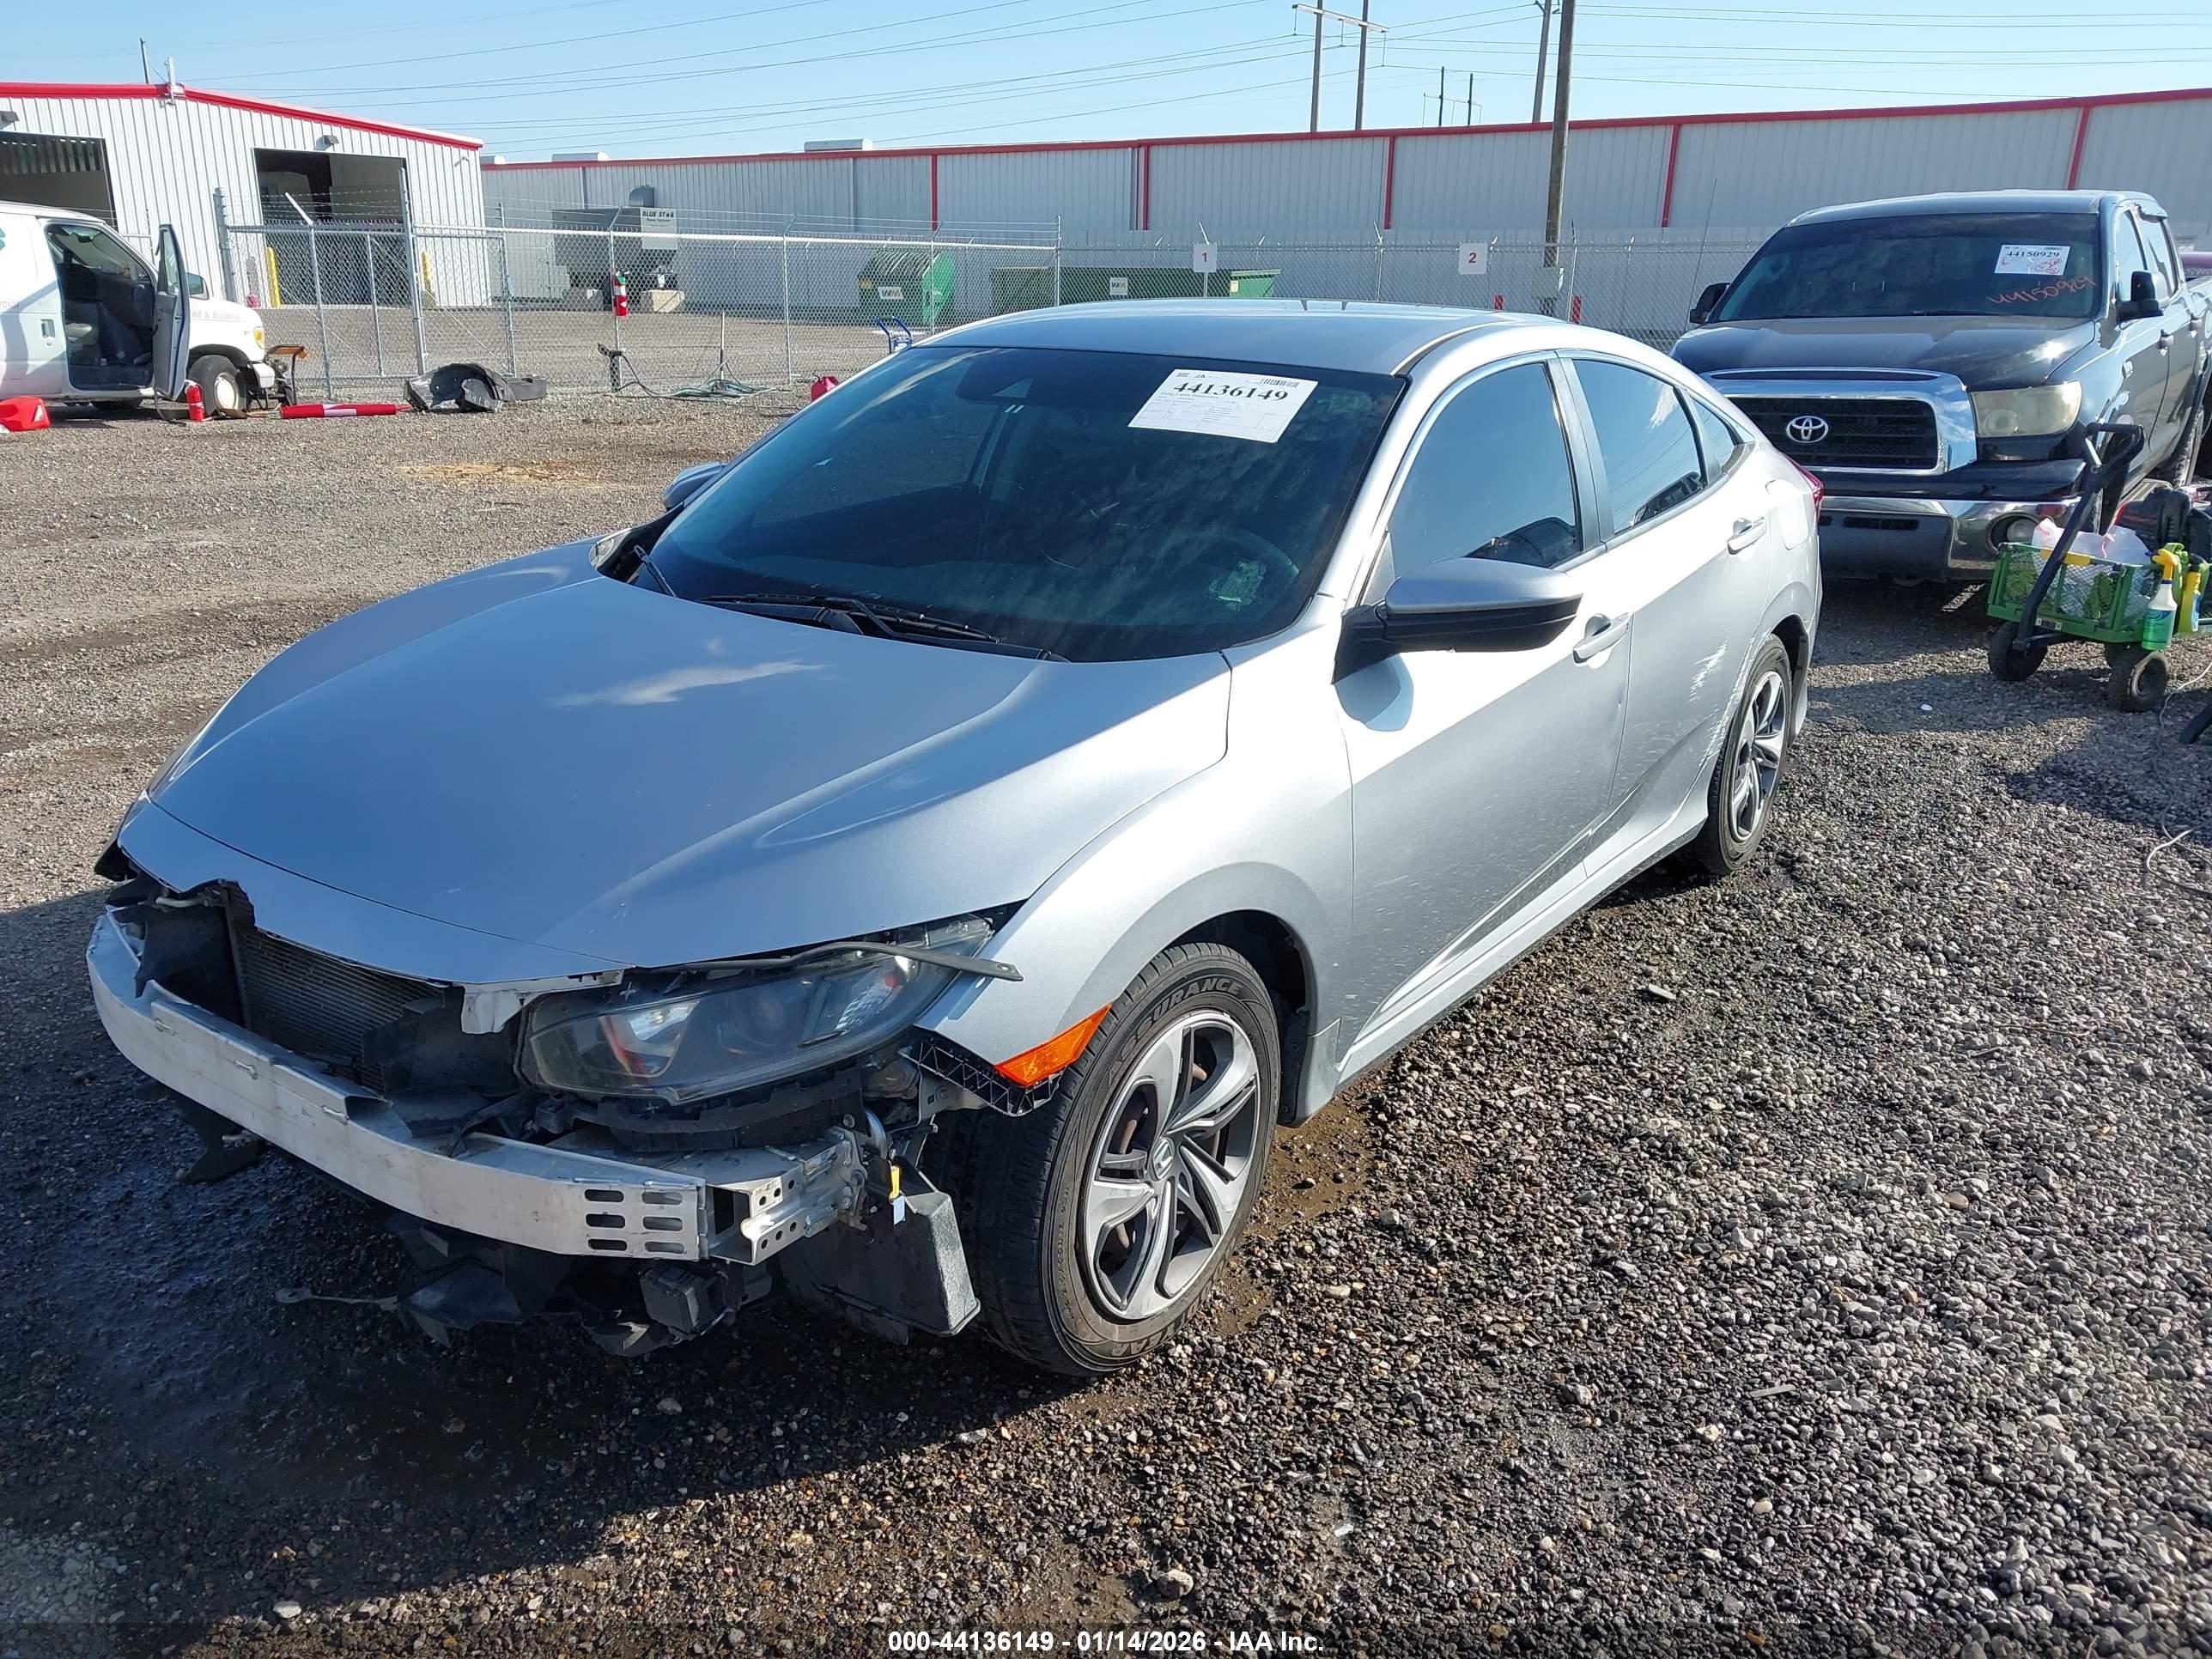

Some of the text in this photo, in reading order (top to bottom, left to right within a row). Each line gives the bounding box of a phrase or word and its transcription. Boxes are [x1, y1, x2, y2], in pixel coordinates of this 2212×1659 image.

[1202, 252, 1208, 263] 1
[1468, 252, 1477, 264] 2
[1173, 382, 1289, 402] 44136149
[1109, 977, 1244, 1087] ASSURANCE
